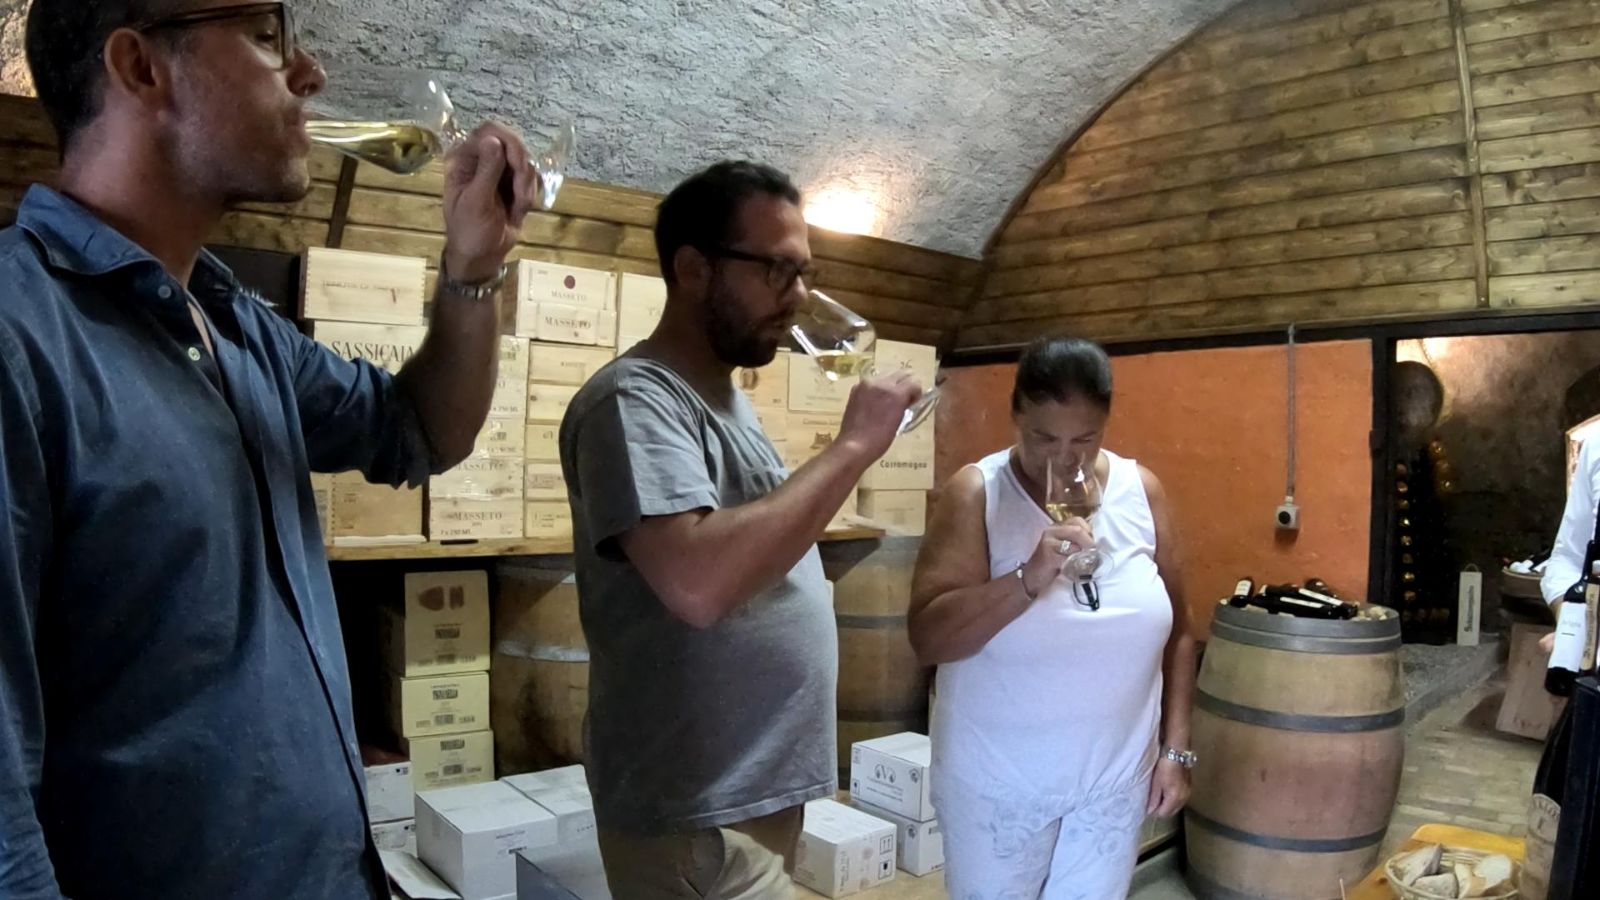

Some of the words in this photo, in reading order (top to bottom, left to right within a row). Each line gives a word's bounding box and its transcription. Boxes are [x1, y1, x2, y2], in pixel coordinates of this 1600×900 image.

[545, 316, 592, 329] MASSETO
[331, 340, 416, 362] SASSICAIA
[452, 511, 503, 521] MASSETO
